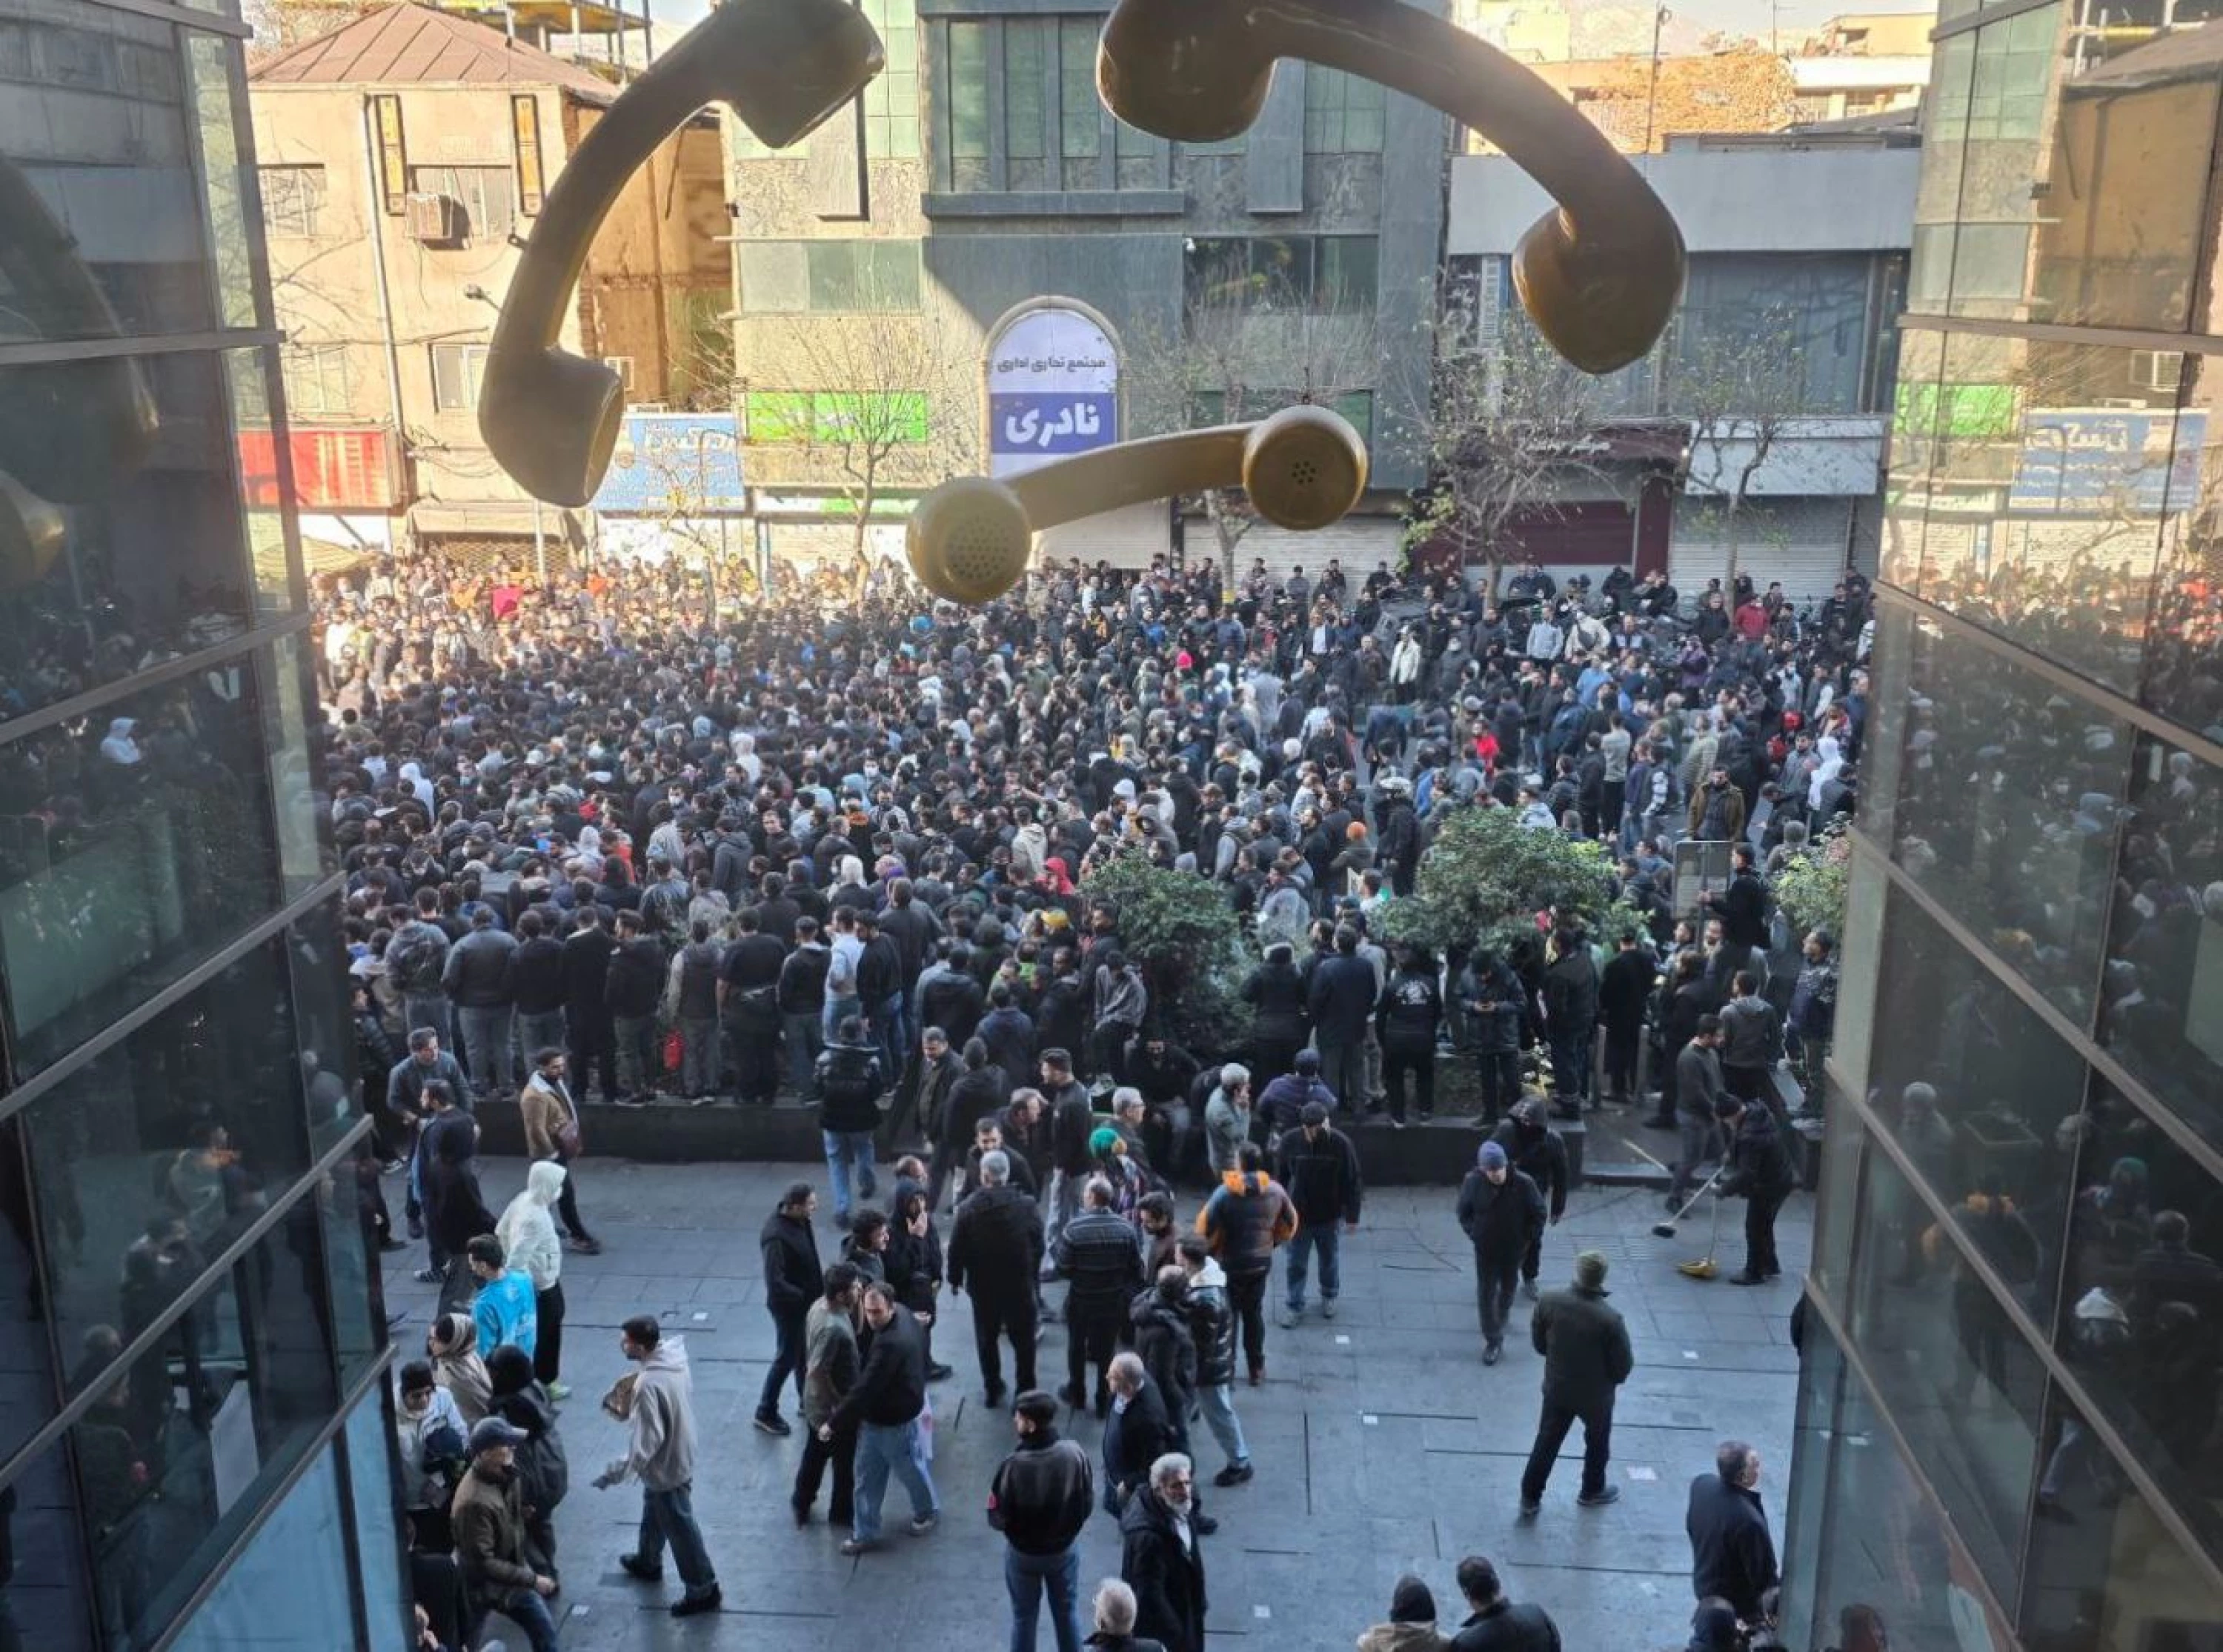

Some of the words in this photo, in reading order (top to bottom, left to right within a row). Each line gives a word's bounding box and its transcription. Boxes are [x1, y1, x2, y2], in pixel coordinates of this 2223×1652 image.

[997, 357, 1029, 372] اداری
[1031, 356, 1065, 372] تجاری
[1066, 356, 1107, 372] مجتمع
[1006, 402, 1100, 447] نادری
